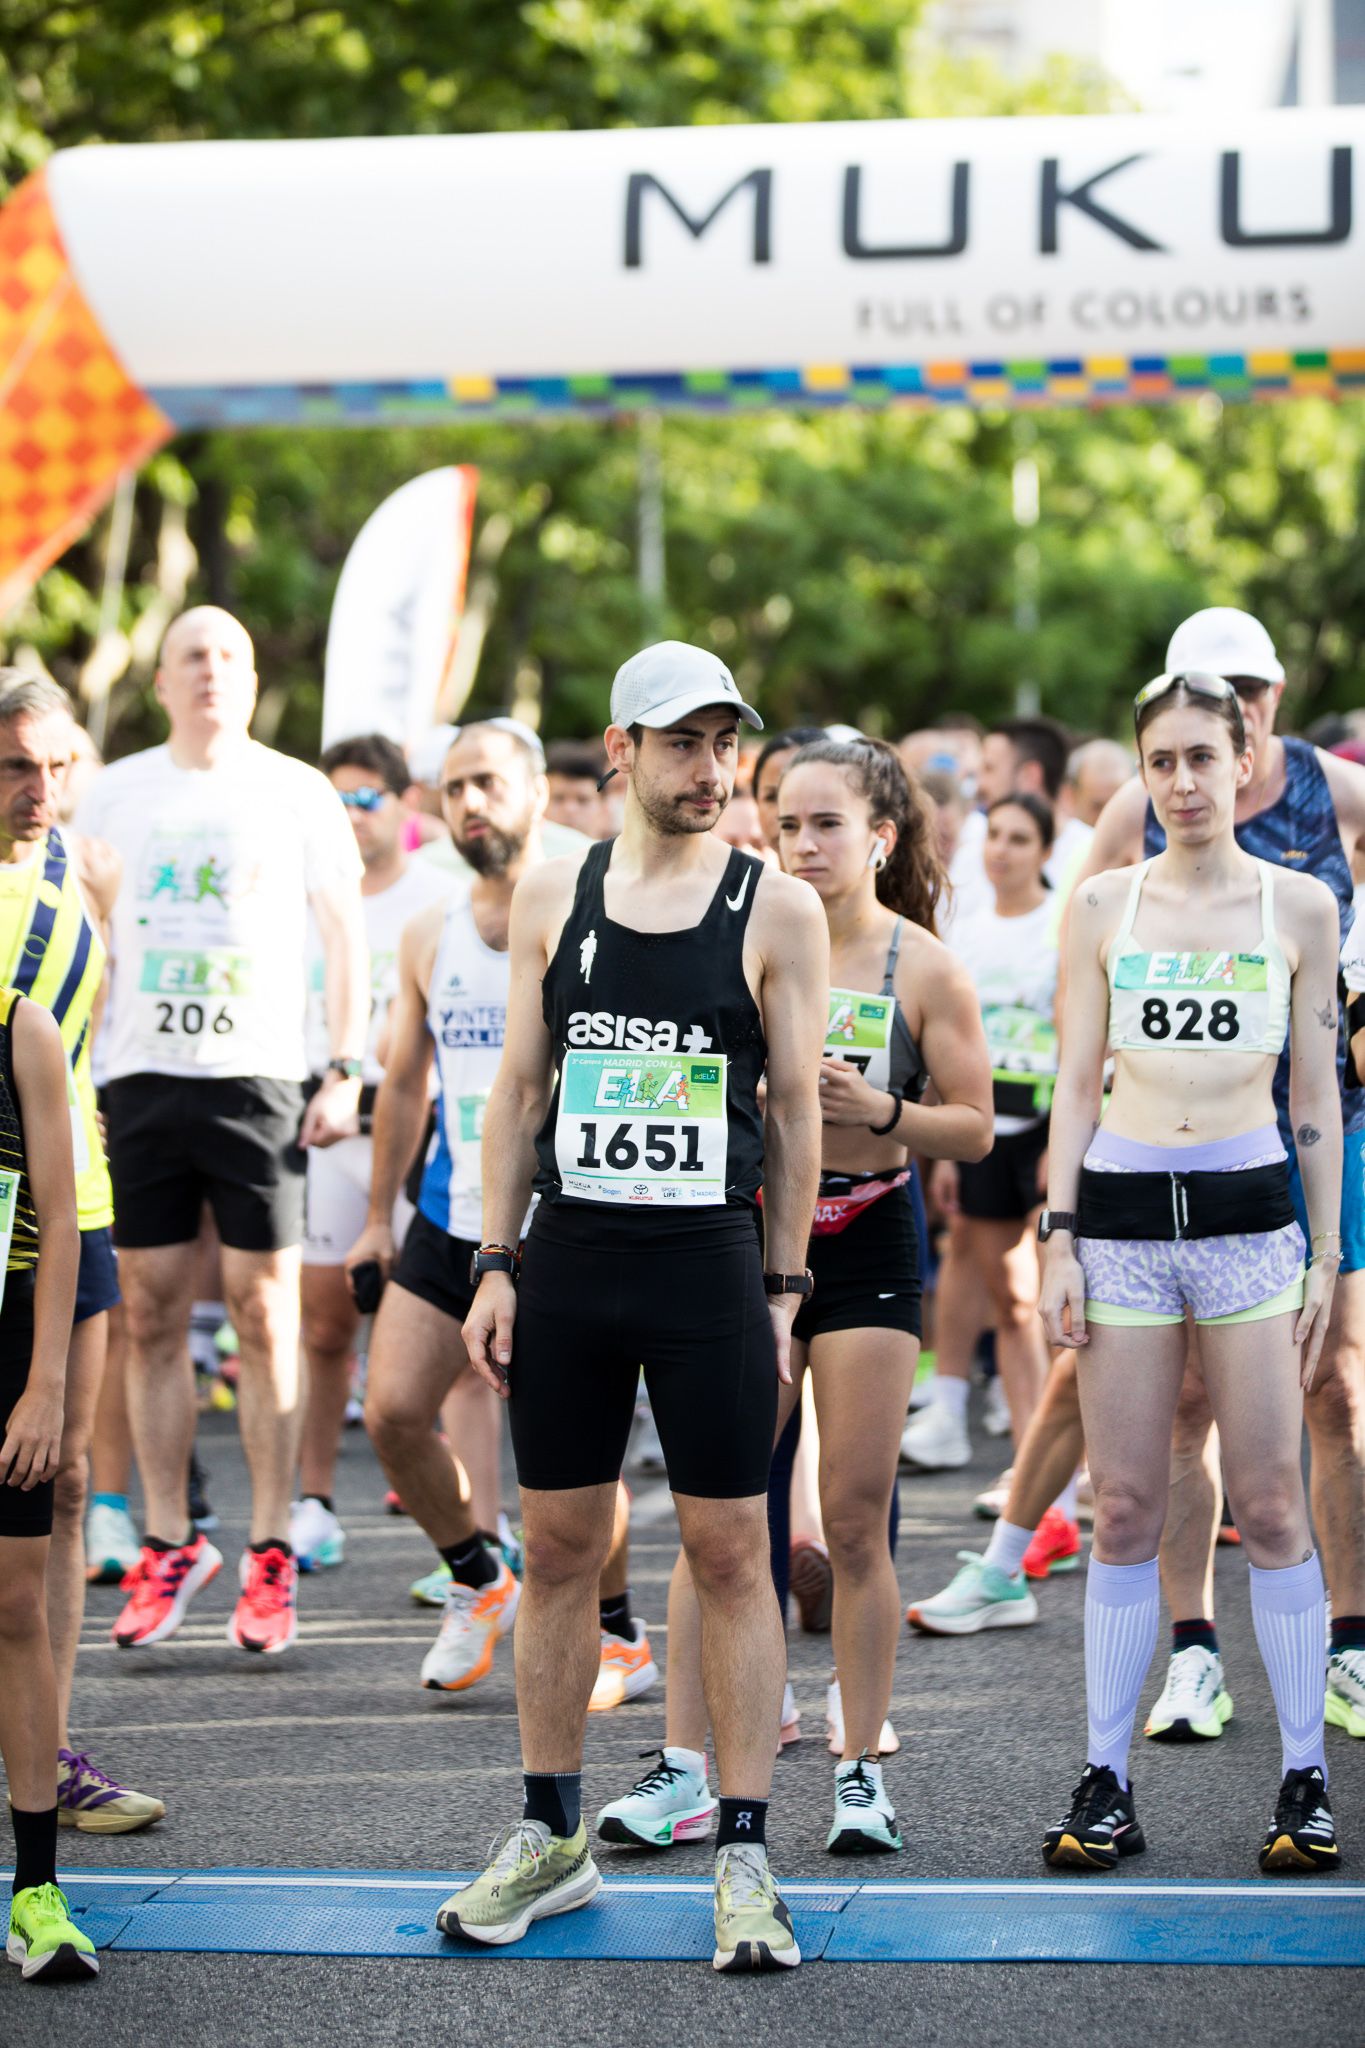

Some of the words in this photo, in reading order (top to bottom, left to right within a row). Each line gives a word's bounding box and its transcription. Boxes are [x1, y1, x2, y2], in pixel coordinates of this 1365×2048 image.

[622, 145, 1354, 269] MUKU
[857, 299, 966, 337] FULL
[986, 295, 1048, 334] OF
[1071, 285, 1313, 331] COLOURS
[1145, 951, 1235, 986] ELA
[154, 1002, 234, 1034] 206
[1141, 997, 1240, 1042] 828
[603, 1058, 643, 1068] MADRID
[645, 1059, 668, 1068] CON
[669, 1060, 682, 1069] LA
[593, 1068, 689, 1111] ELA
[577, 1122, 704, 1172] 1651
